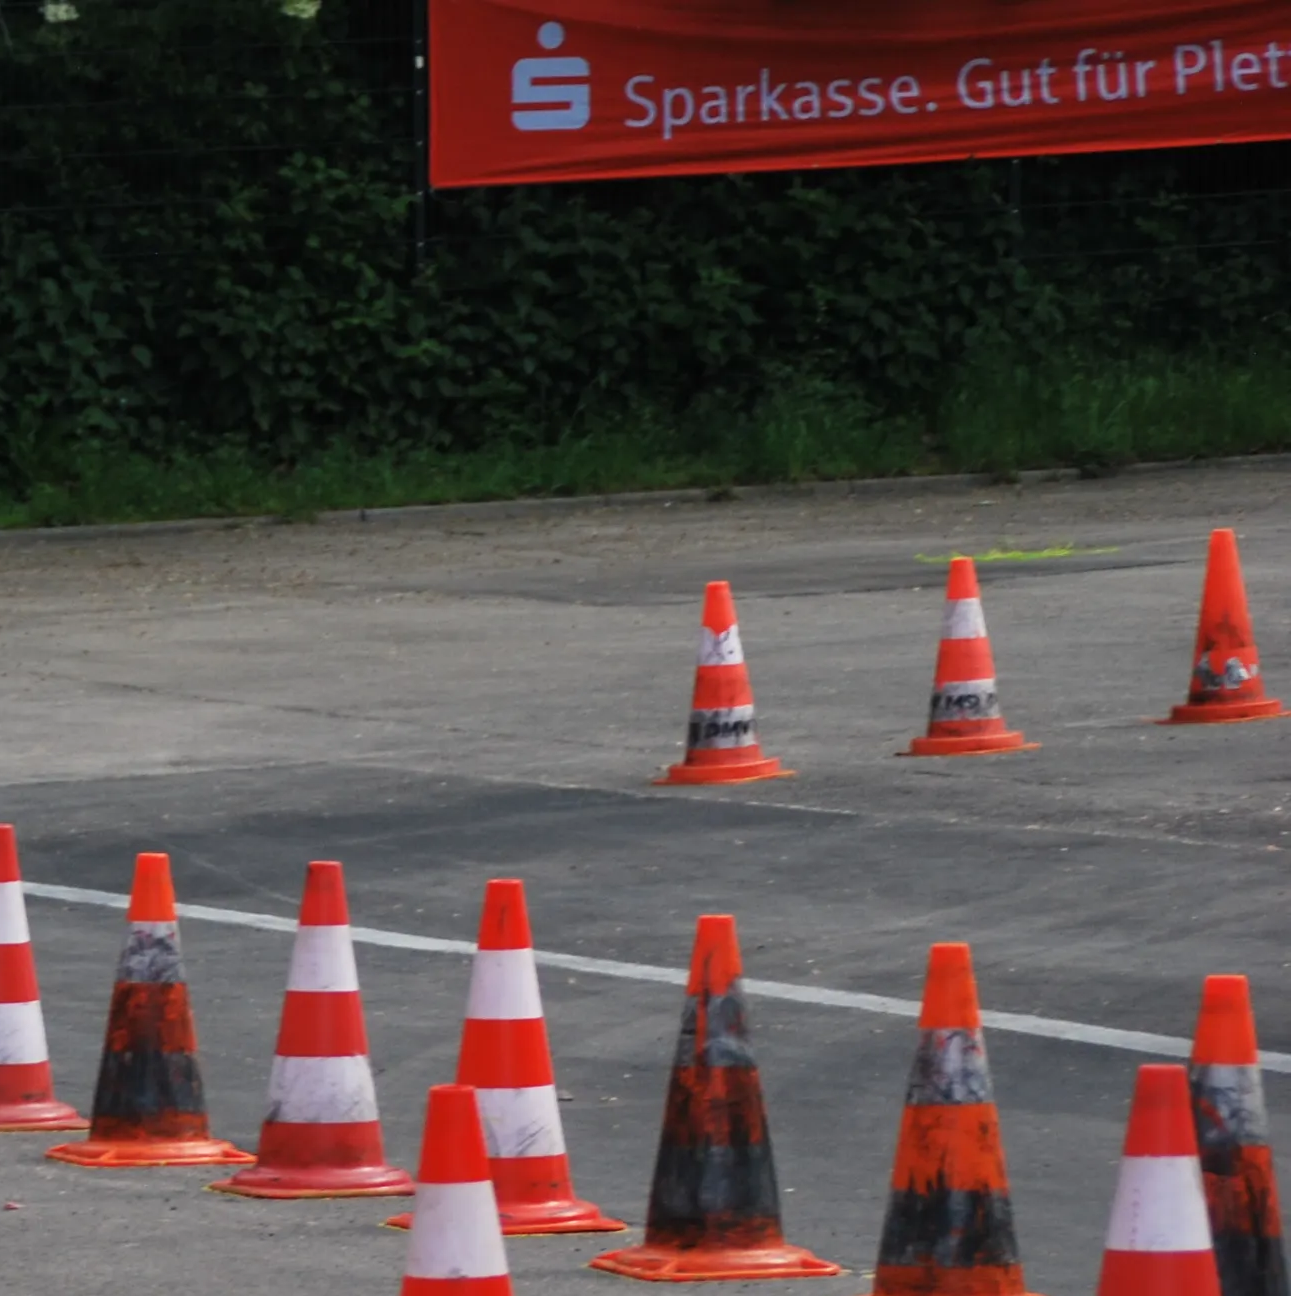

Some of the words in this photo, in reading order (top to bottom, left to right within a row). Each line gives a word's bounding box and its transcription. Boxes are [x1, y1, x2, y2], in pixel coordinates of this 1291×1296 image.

[624, 67, 938, 140] Sparkasse.
[957, 57, 1060, 109] Gut
[1072, 47, 1158, 102] für
[1174, 39, 1291, 96] Plet
